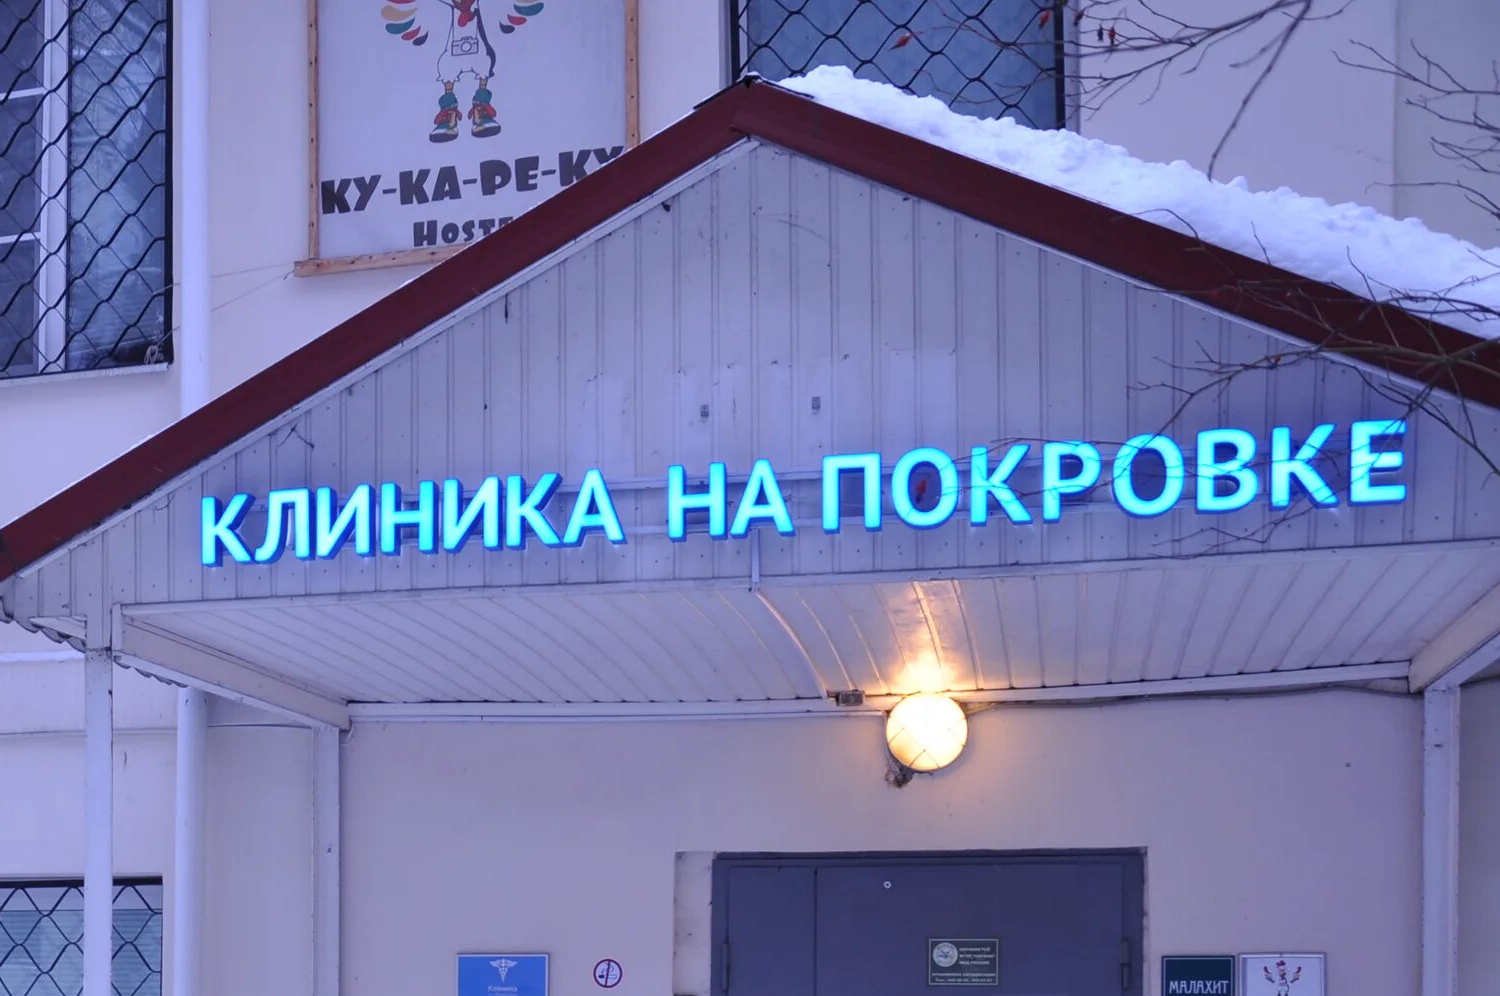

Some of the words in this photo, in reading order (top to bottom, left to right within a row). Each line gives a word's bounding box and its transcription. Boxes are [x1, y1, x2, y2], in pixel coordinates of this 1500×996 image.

[413, 216, 514, 247] HOST
[202, 468, 626, 567] КЛИНИКА
[667, 459, 793, 542] НА
[821, 420, 1407, 533] ПОКРОВКЕ
[1169, 980, 1229, 994] МАЛАХИТ
